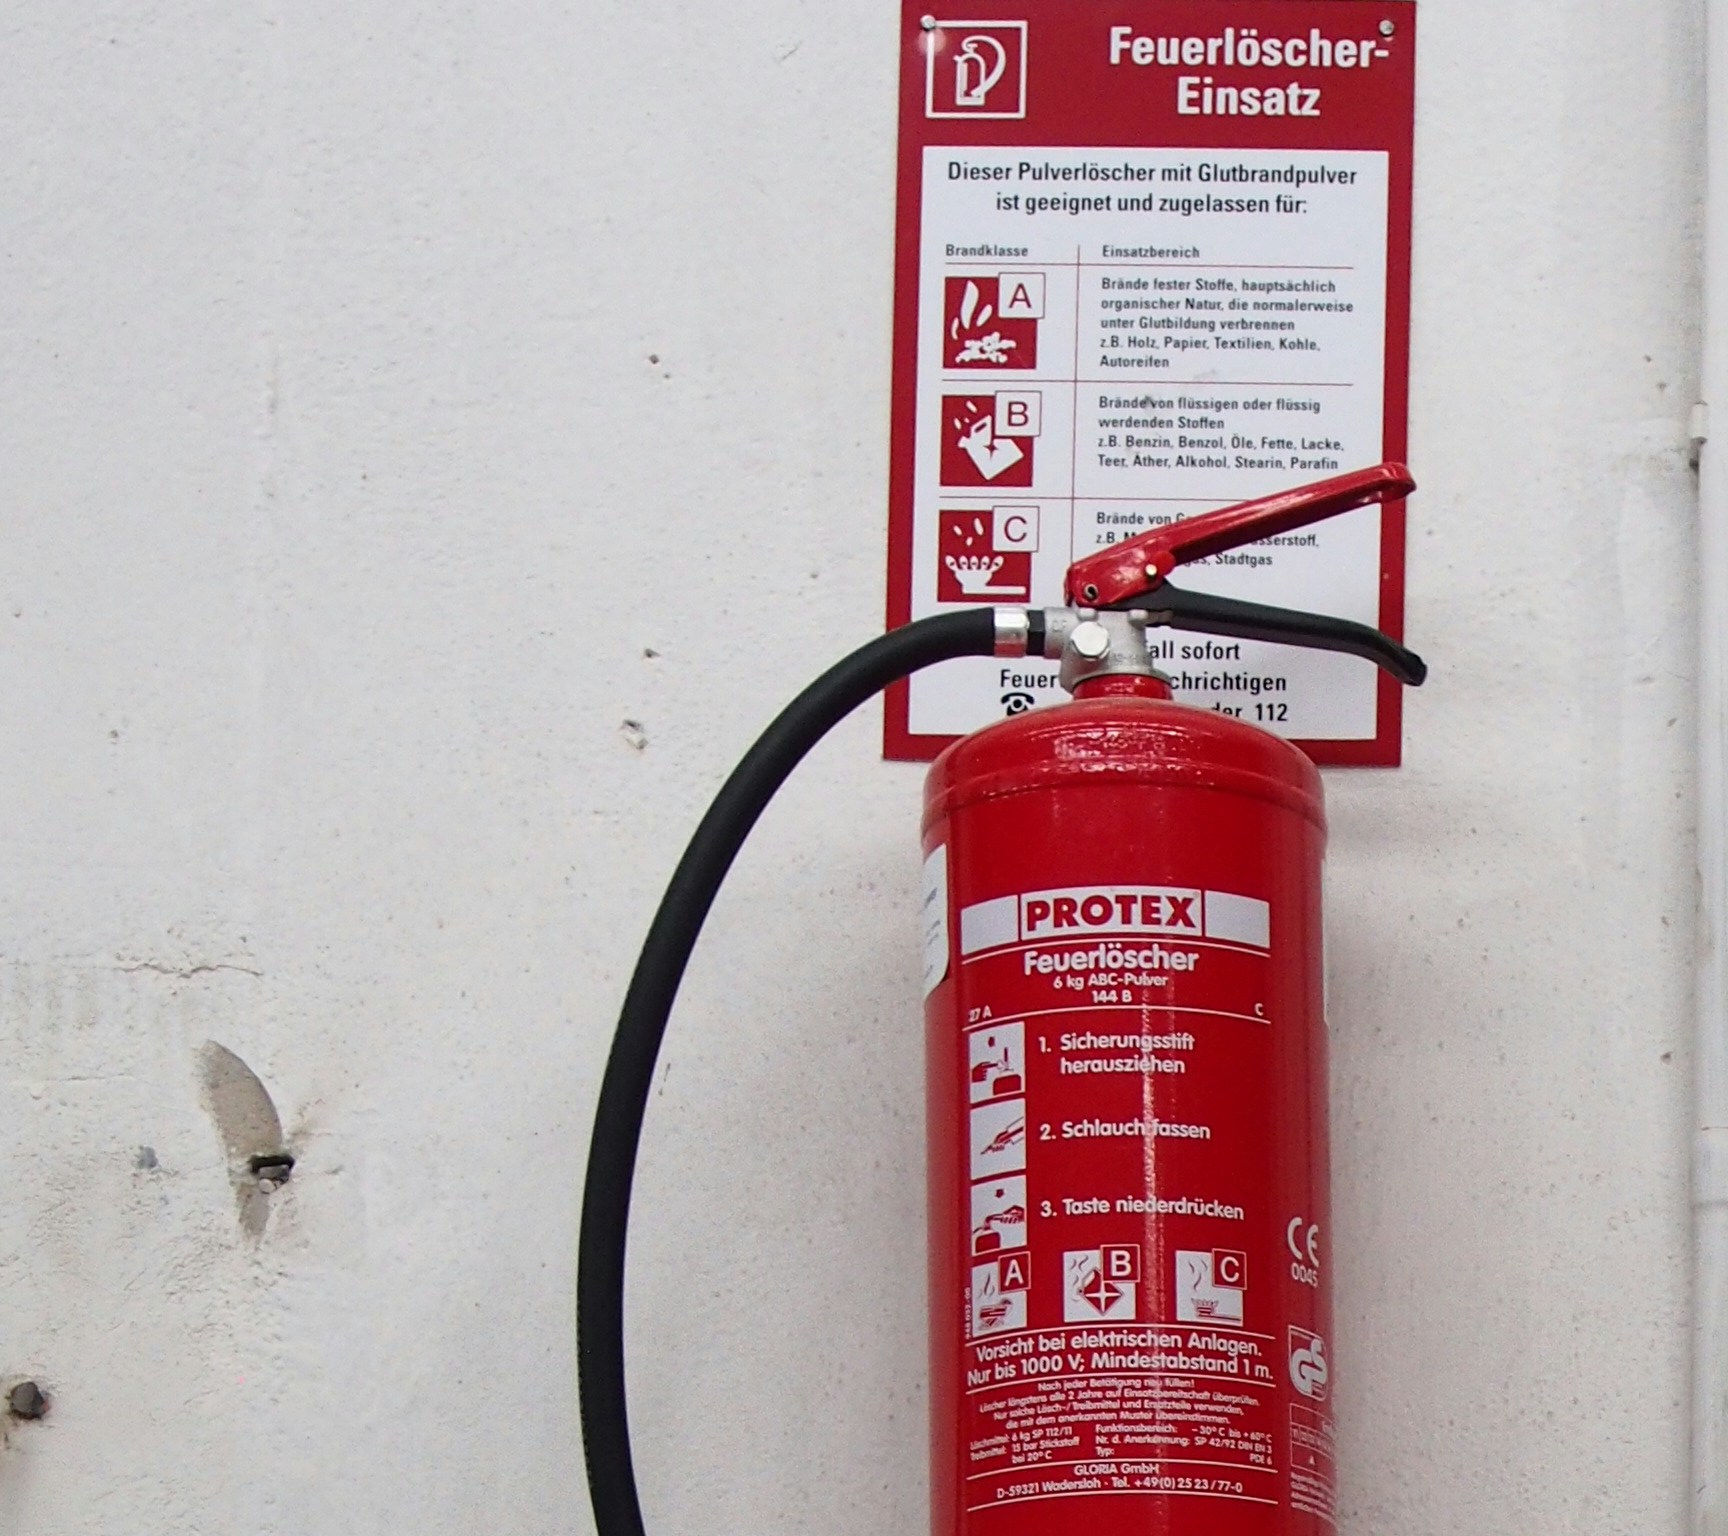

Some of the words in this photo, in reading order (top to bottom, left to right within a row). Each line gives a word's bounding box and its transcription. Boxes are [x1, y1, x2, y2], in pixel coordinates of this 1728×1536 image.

[1110, 26, 1389, 68] Feuerlöscher-
[1177, 77, 1320, 116] Einsatz
[948, 162, 1012, 181] Dieser
[1019, 162, 1155, 182] Pulverlöscher
[1161, 163, 1191, 182] mit
[1198, 163, 1357, 187] Glutbrandpulver
[996, 193, 1020, 210] ist
[1025, 194, 1111, 214] geeignet
[1118, 195, 1153, 212] und
[1159, 195, 1270, 215] zugelassen
[1275, 195, 1308, 214] für:
[945, 244, 1029, 257] Brandklasse
[1102, 245, 1200, 258] Einsatzbereich
[1101, 277, 1149, 290] Brände
[1153, 278, 1191, 290] fester
[1196, 278, 1238, 292] Stoffe,
[1241, 278, 1336, 294] hauptsächlich
[1009, 282, 1032, 309] A
[1101, 298, 1180, 312] organischer
[1185, 298, 1224, 311] Natur,
[1228, 299, 1249, 311] die
[1253, 299, 1354, 312] normalerweise
[1100, 317, 1135, 329] unter
[1139, 317, 1216, 332] Glutbildung
[1219, 318, 1295, 331] verbrennen
[1100, 336, 1123, 348] z.B.
[1128, 336, 1160, 350] Holz,
[1164, 337, 1210, 351] Papier,
[1214, 337, 1275, 351] Textilien,
[1279, 338, 1321, 351] Kohle,
[1100, 355, 1170, 368] Autoreifen
[1099, 396, 1147, 409] Brände
[1151, 398, 1174, 409] von
[1177, 397, 1239, 411] flüssigen
[1242, 398, 1272, 410] oder
[1276, 398, 1321, 413] flüssig
[1008, 403, 1029, 427] B
[1098, 417, 1174, 429] werdenden
[1178, 417, 1225, 429] Stoffen
[1098, 436, 1121, 448] z.B.
[1126, 436, 1174, 450] Benzin,
[1178, 437, 1227, 450] Benzol,
[1231, 433, 1257, 450] Öle,
[1261, 438, 1298, 451] Fette,
[1301, 438, 1345, 452] Lacke,
[1098, 455, 1130, 469] Teer,
[1175, 456, 1231, 469] Alkohol,
[1234, 456, 1287, 470] Stearin,
[1290, 457, 1339, 470] Parafin
[1096, 511, 1144, 525] Brände
[1148, 513, 1172, 525] von
[1004, 517, 1027, 543] C
[1250, 534, 1320, 548] asserstoff,
[1215, 552, 1273, 566] Stadtgas
[1181, 640, 1241, 660] sofort
[1000, 669, 1057, 689] Feuer
[1170, 672, 1287, 695] chrichtigen
[1256, 703, 1288, 722] 112
[1027, 894, 1196, 932] PROTEX
[1024, 943, 1199, 975] Feuerlöscher
[1054, 976, 1063, 989] 6
[1066, 975, 1084, 990] kg
[1088, 973, 1168, 987] ABC-Pulver
[1092, 991, 1118, 1003] 144
[1121, 991, 1132, 1003] B
[1255, 1003, 1263, 1016] C
[1038, 1037, 1052, 1053] 1.
[1060, 1032, 1195, 1053] Sicherungsstift
[1060, 1055, 1185, 1075] herausziehen
[1040, 1123, 1056, 1140] 2.
[1061, 1118, 1146, 1139] Schlauch
[1151, 1119, 1211, 1140] fassen
[1040, 1201, 1057, 1217] 3.
[1062, 1198, 1110, 1215] Taste
[1116, 1197, 1244, 1220] niederdrücken
[1004, 1260, 1024, 1287] A
[1110, 1251, 1131, 1277] B
[1220, 1257, 1239, 1282] C
[976, 1338, 1035, 1362] Vorsicht
[1039, 1333, 1066, 1352] bei
[1071, 1331, 1182, 1349] elektrischen
[1188, 1333, 1262, 1356] Anlagen.
[967, 1369, 992, 1387] Nur
[995, 1361, 1017, 1380] bis
[1021, 1356, 1063, 1375] 1000
[1066, 1354, 1085, 1372] V;
[1091, 1350, 1238, 1374] Mindestabstand
[1243, 1357, 1250, 1375] 1
[1254, 1364, 1274, 1379] m.
[1038, 1381, 1061, 1392] Nach
[1063, 1380, 1088, 1391] jeder
[1022, 1441, 1038, 1451] bar
[1074, 1463, 1118, 1476] GLORIA
[1120, 1463, 1160, 1474] GmbH
[1111, 1476, 1131, 1488] Tel.
